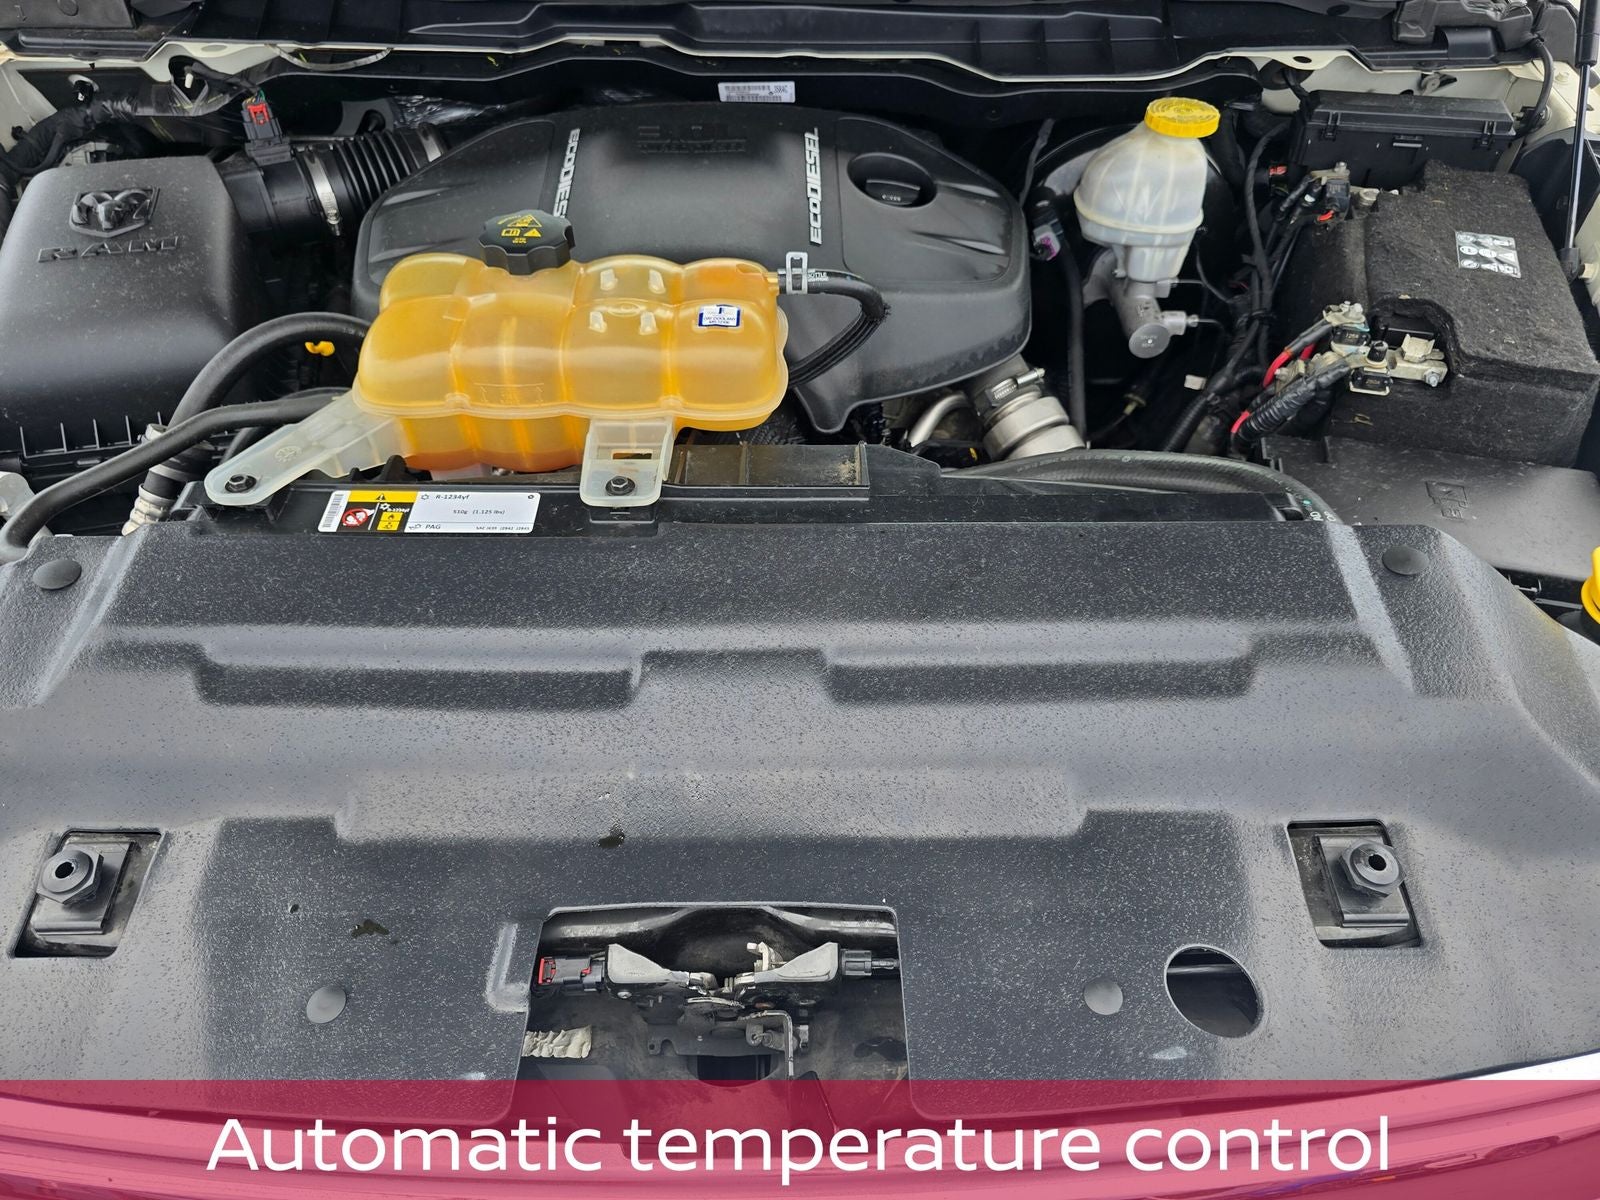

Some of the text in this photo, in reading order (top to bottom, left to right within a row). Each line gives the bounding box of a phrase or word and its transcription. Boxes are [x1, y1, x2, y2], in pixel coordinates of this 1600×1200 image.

[553, 128, 580, 219] ECODIES
[804, 127, 822, 245] ECODIESEL
[37, 236, 179, 262] RAM
